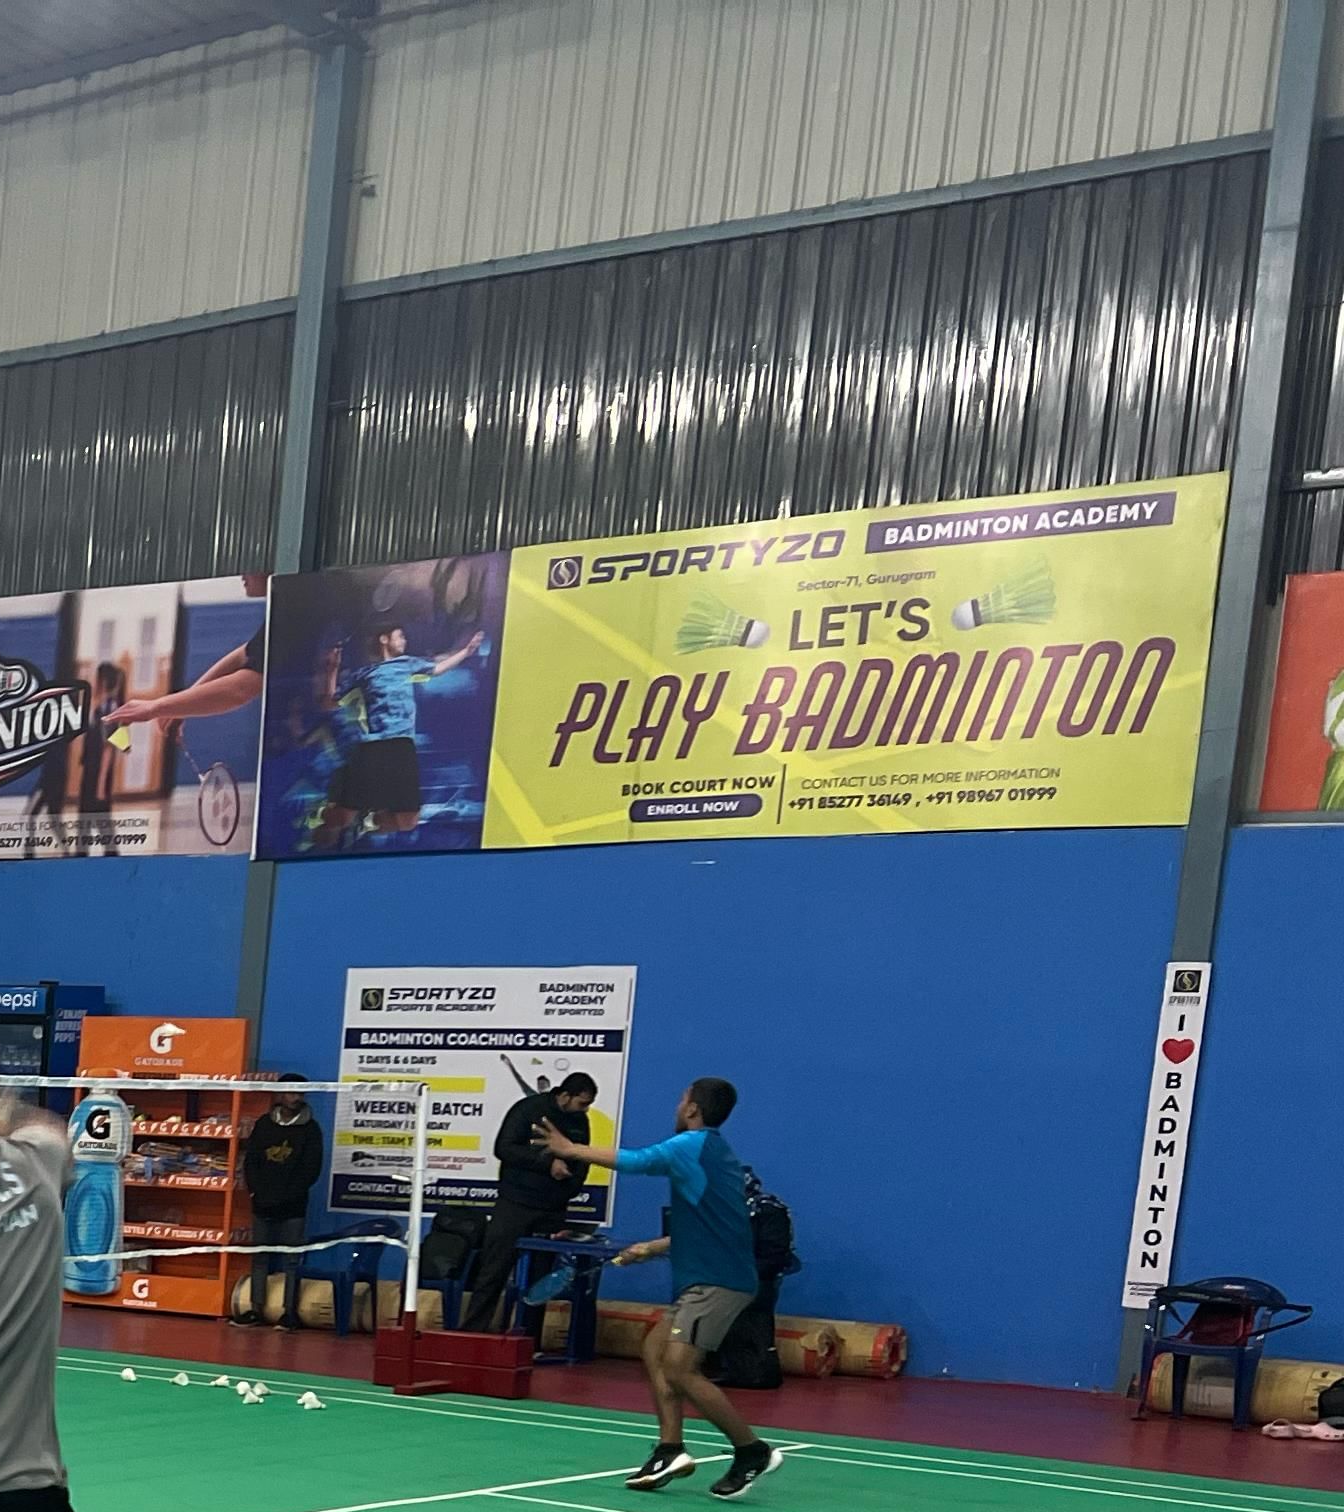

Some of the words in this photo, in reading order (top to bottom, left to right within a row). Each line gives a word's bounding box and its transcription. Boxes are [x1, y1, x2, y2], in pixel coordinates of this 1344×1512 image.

[884, 514, 1027, 546] BADMINTON
[1033, 499, 1160, 533] ACADEMY
[586, 529, 847, 586] SPORTYZO
[796, 575, 864, 594] Sector-71,
[866, 568, 938, 589] Gurugram
[788, 596, 932, 652] LET'S
[549, 667, 727, 768] PLAY
[738, 635, 1178, 757] BADMINTON
[621, 782, 665, 798] BOOK
[670, 778, 728, 795] COURT
[730, 774, 777, 791] NOW
[801, 776, 867, 790] CONTACT
[869, 774, 888, 787] US
[891, 773, 919, 786] FOR
[922, 771, 962, 785] MORE
[964, 767, 1062, 783] INFORMATION
[646, 802, 701, 817] ENROLL
[703, 799, 741, 814] NOW
[788, 796, 814, 811] +91
[925, 790, 954, 805] +91
[1008, 786, 1058, 801] 01999
[388, 987, 497, 1000] SPORTYZO
[539, 983, 615, 993] BADMINTON
[386, 1003, 434, 1012] SPORTS
[544, 995, 607, 1005] ACADEMY
[1177, 1013, 1186, 1032] I
[360, 1032, 444, 1046] BADMINTON
[446, 1033, 526, 1047] COACHING
[527, 1033, 605, 1048] SCHEDULE
[354, 1100, 417, 1115] WEEKEN
[432, 1102, 484, 1117] BATCH
[1140, 1071, 1183, 1269] BADMINTON
[348, 1181, 396, 1193] CONTACT
